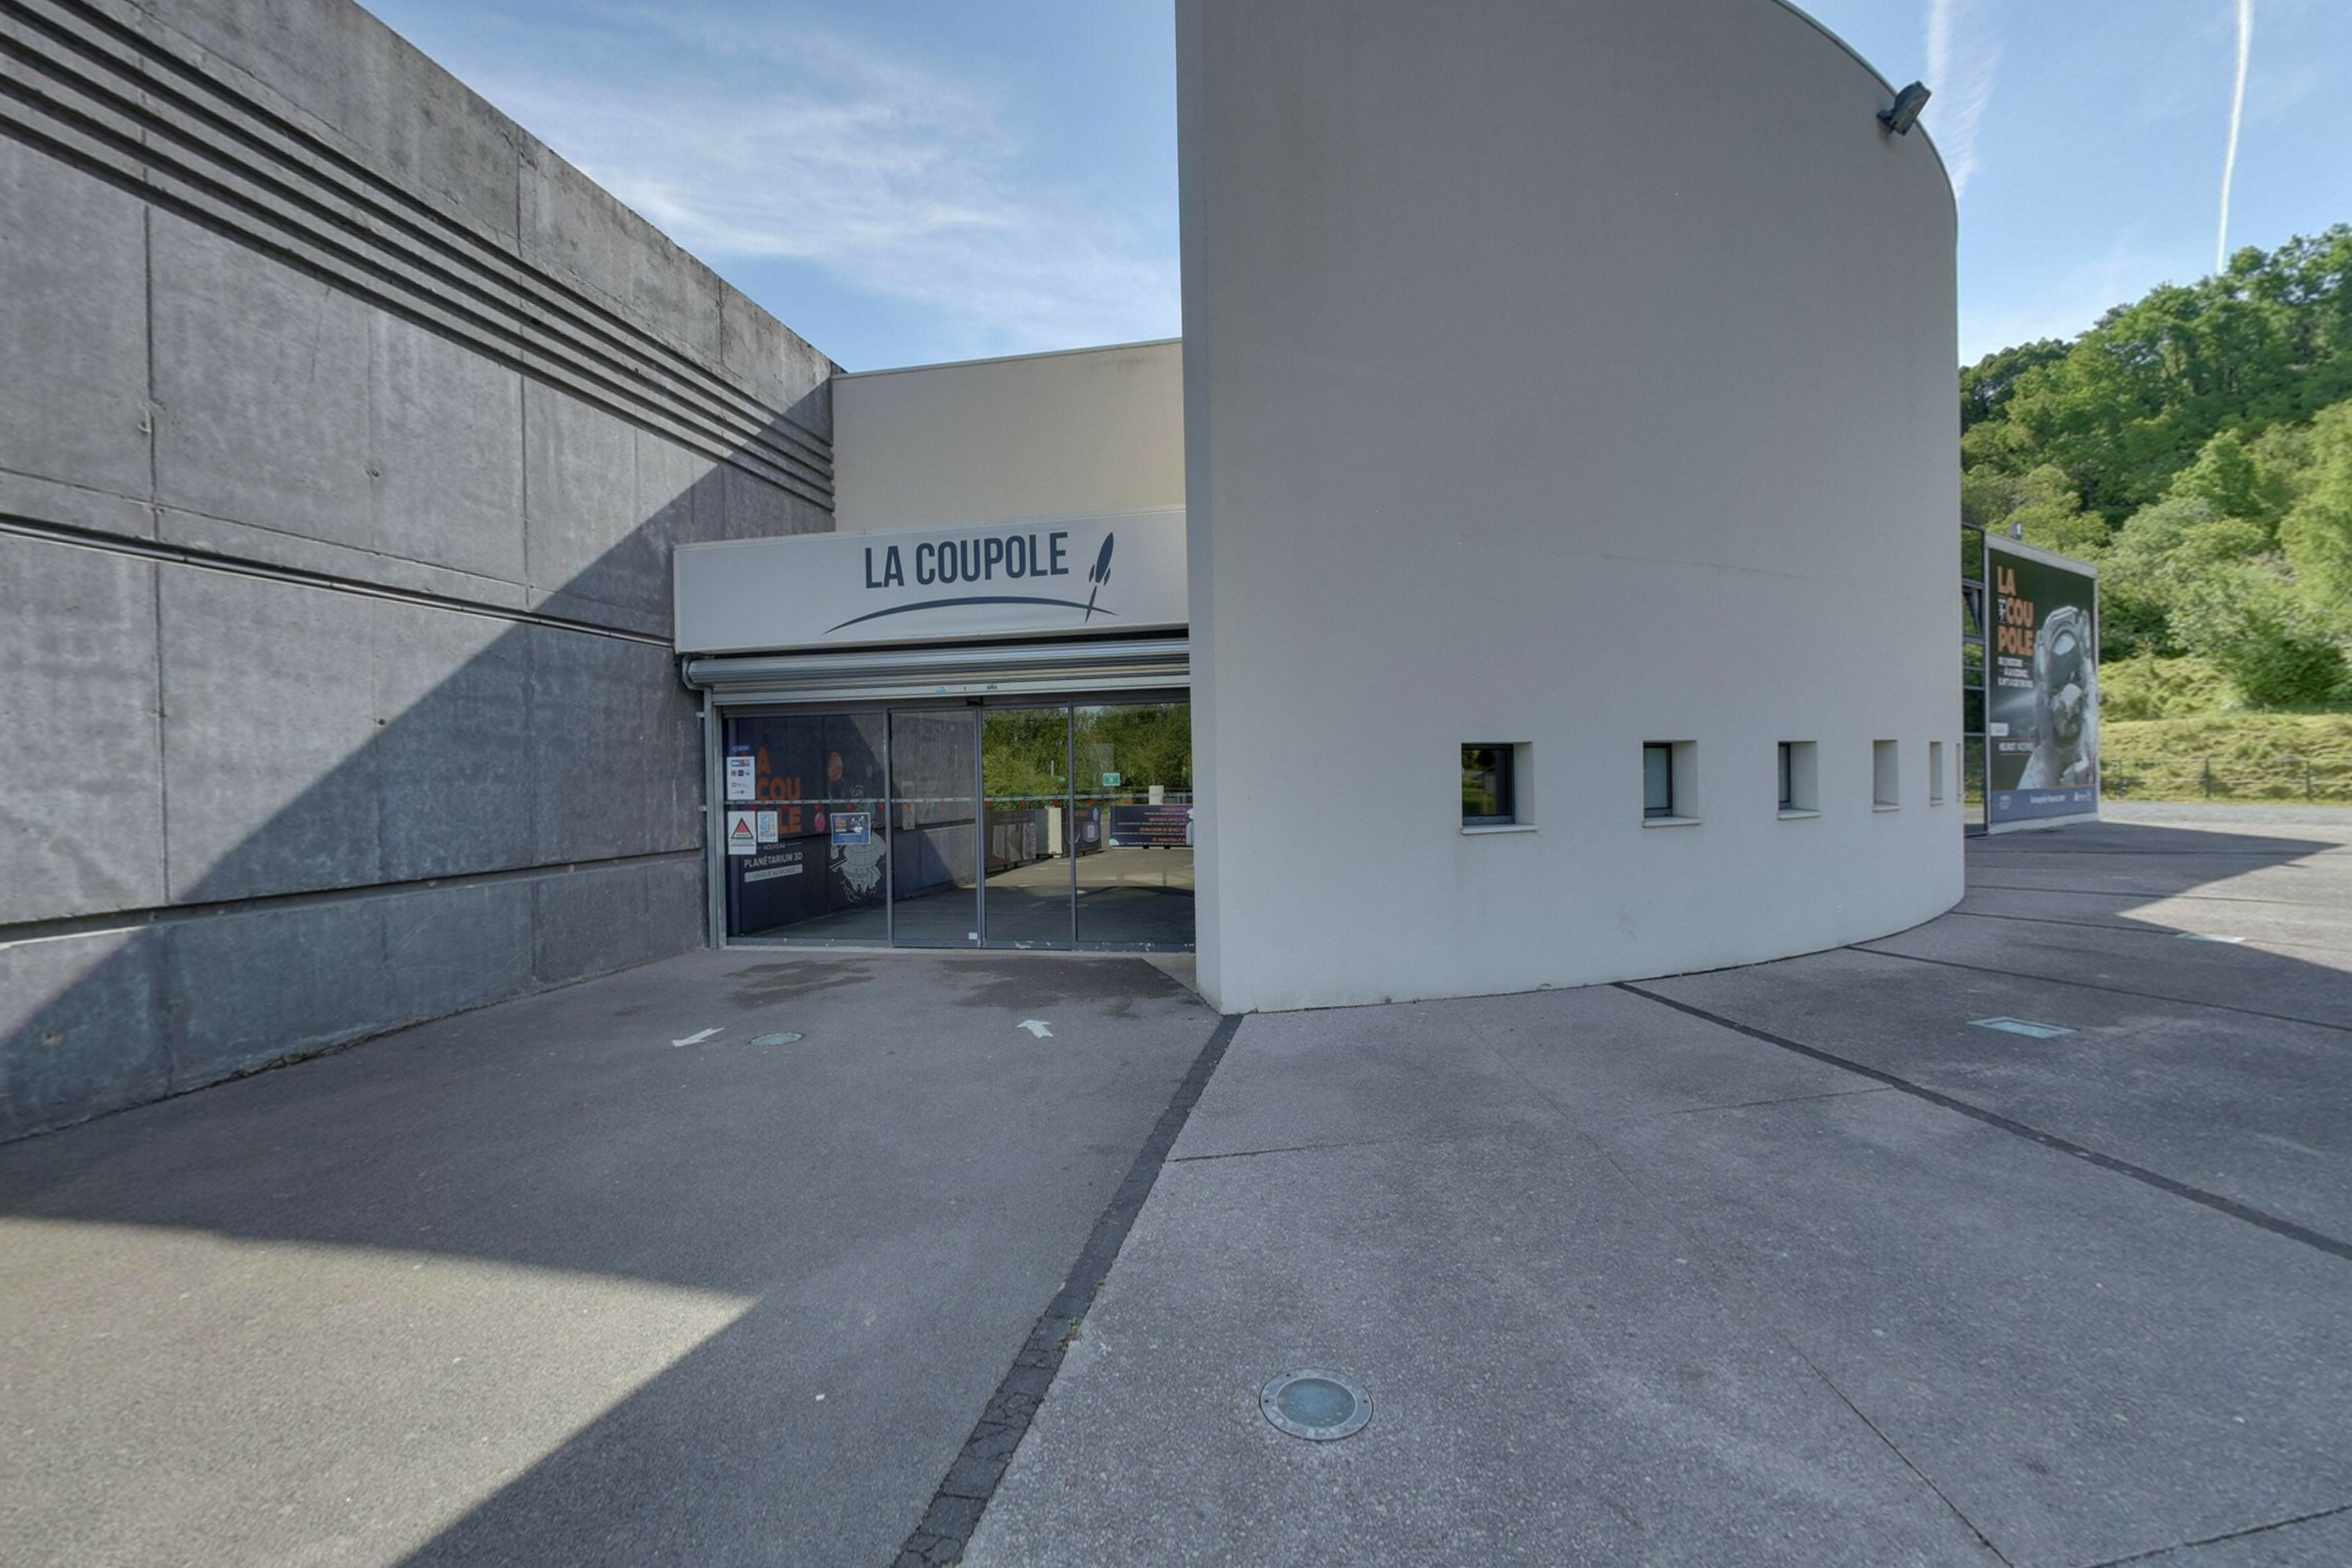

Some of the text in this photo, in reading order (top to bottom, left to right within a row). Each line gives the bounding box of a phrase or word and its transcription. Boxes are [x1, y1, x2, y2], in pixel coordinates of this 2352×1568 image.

[866, 532, 1069, 589] LA COUPOLE
[1998, 565, 2016, 596] LA
[2006, 597, 2034, 627] COU
[1998, 625, 2034, 656] POLE
[756, 777, 801, 800] COU
[744, 851, 804, 868] PLANÉTARIUM 3D
